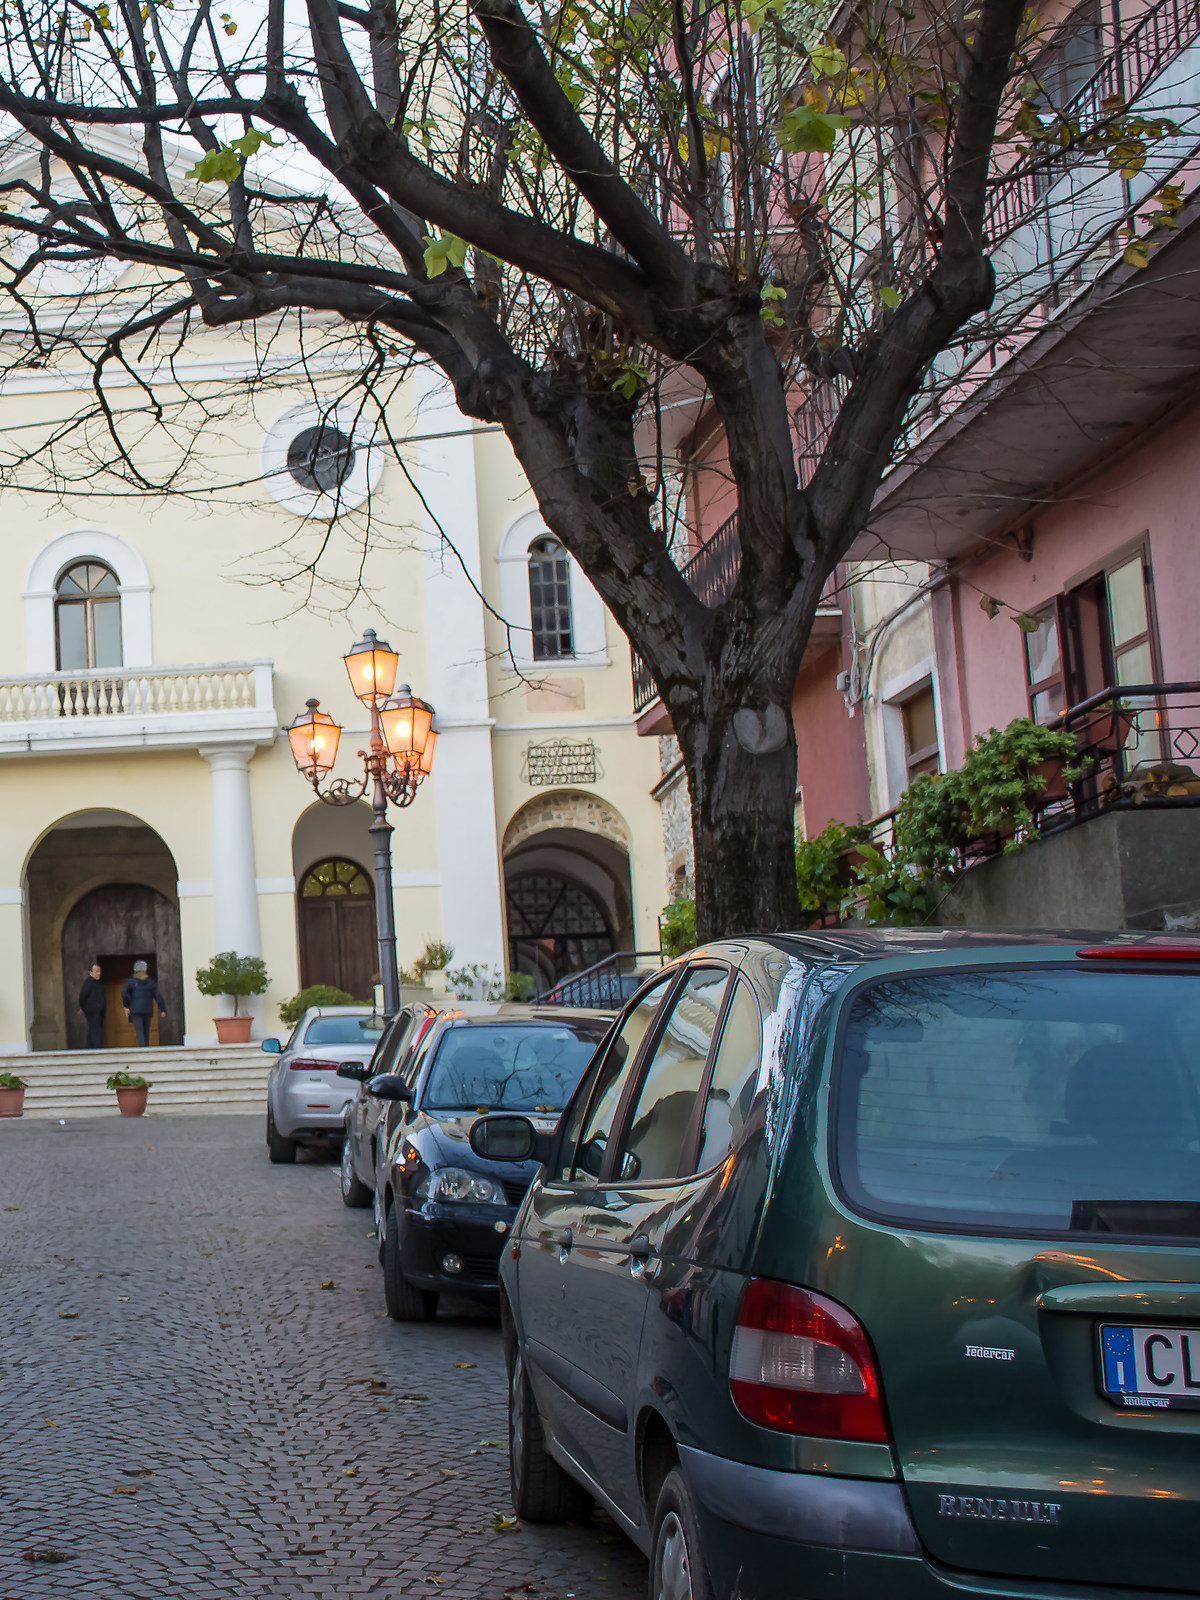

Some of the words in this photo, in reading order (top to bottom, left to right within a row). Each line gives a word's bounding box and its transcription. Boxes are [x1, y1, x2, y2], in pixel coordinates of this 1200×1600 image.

[965, 1345, 1015, 1361] Federcar
[1123, 1395, 1170, 1408] Federcar
[938, 1494, 1061, 1524] RENAULT
